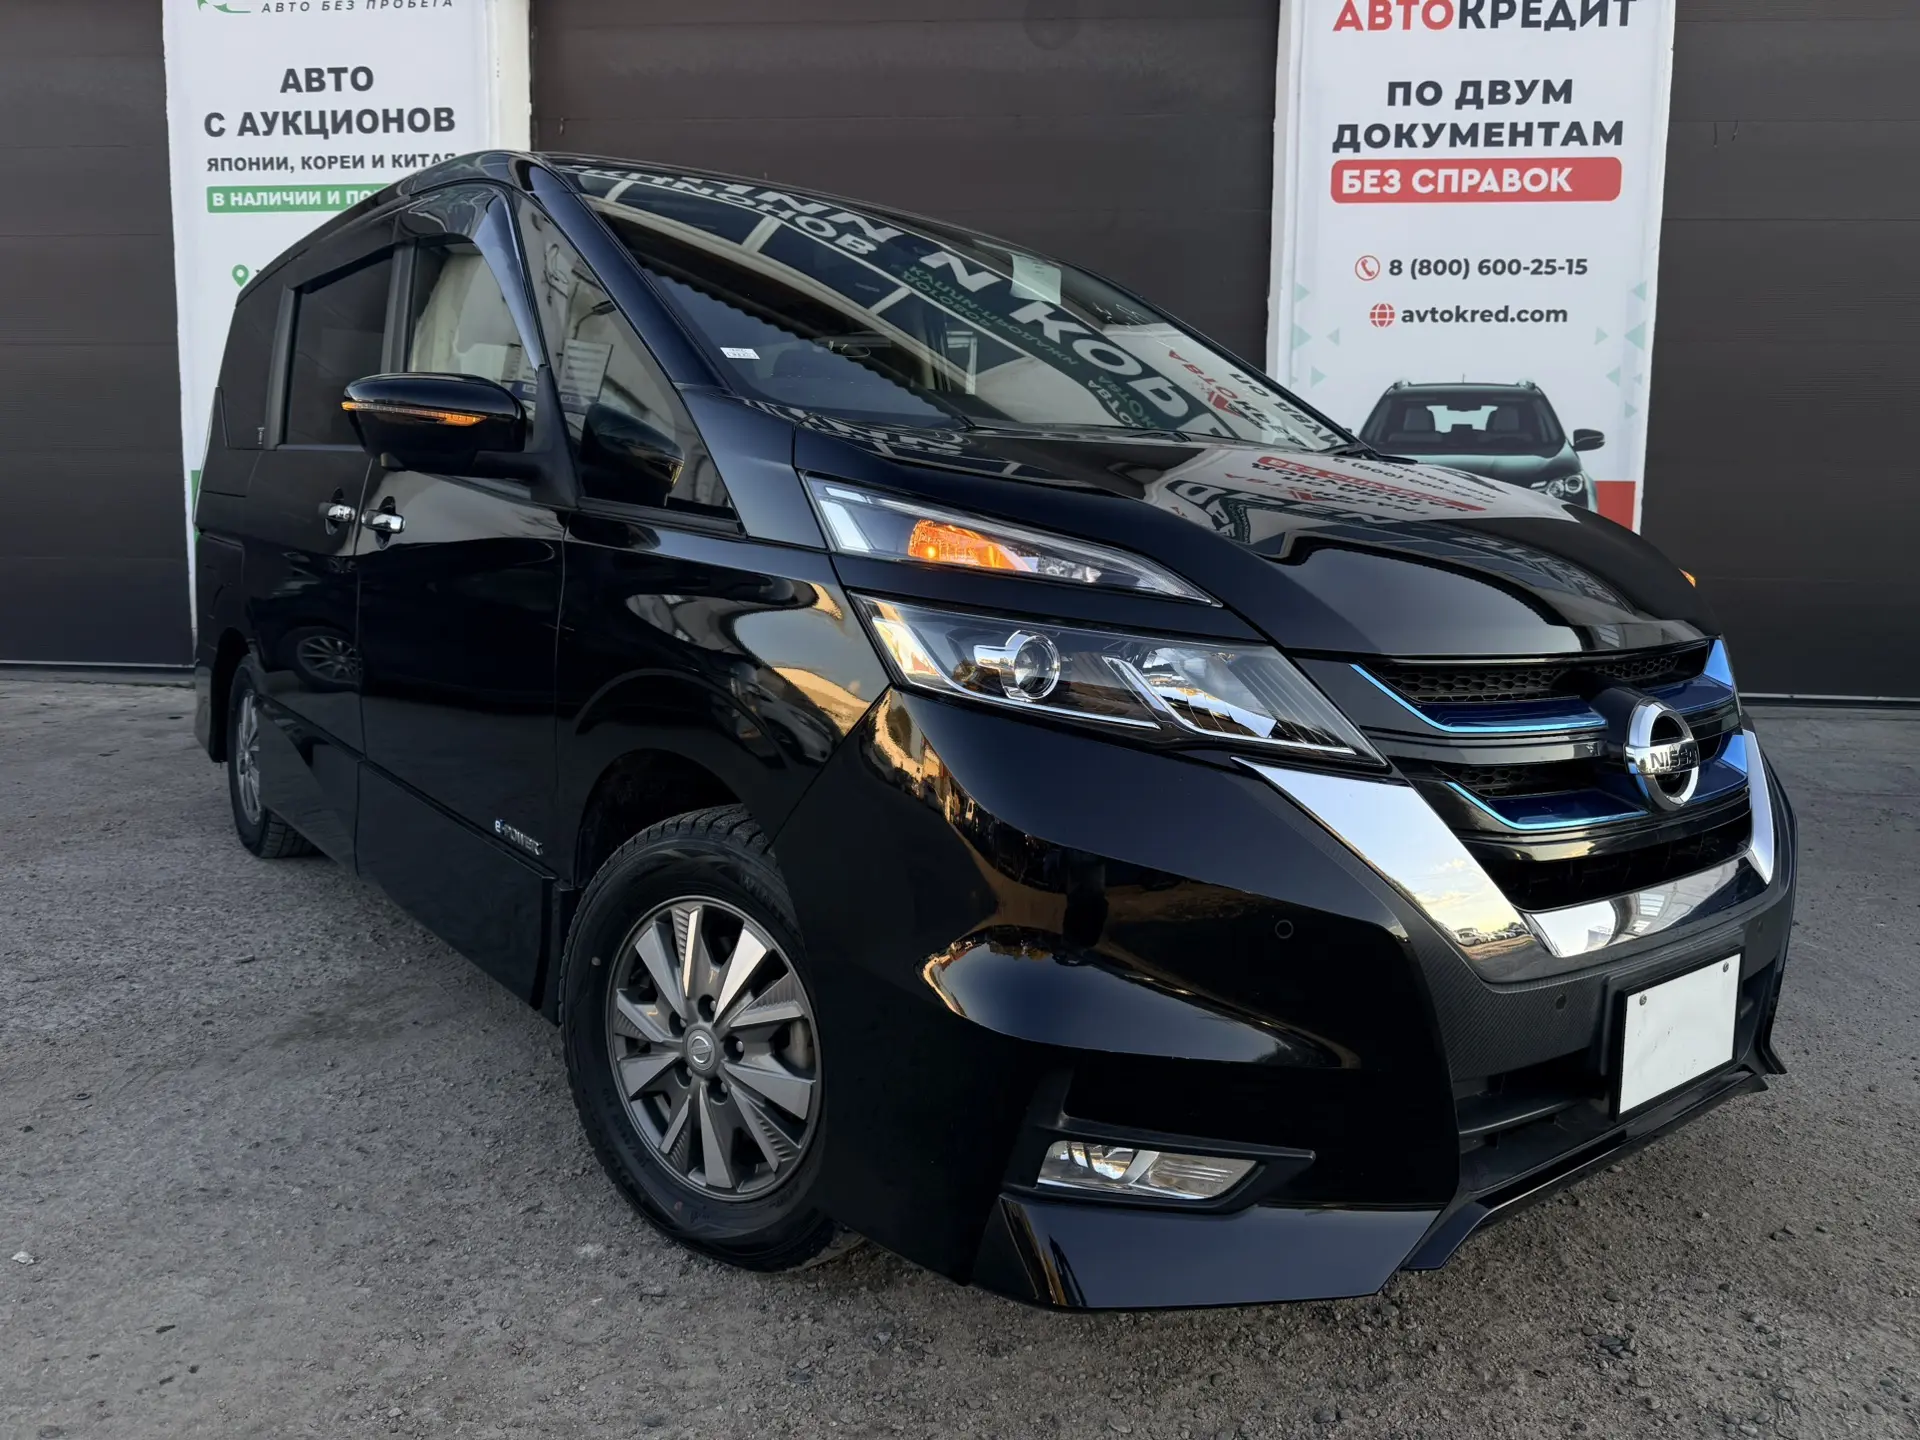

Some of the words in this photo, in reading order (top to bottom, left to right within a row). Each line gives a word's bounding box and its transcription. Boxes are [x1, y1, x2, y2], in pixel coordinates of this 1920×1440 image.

[261, 2, 310, 13] АВТО
[321, 0, 355, 12] БЕЗ
[1332, 0, 1637, 32] АВТОКРЕДИТ
[279, 66, 375, 94] АВТО
[1387, 80, 1443, 107] ПО
[1455, 78, 1574, 111] ДВУМ
[203, 112, 227, 138] С
[237, 106, 456, 140] АУКЦИОНОВ
[1332, 120, 1624, 154] ДОКУМЕНТАМ
[206, 156, 296, 173] ЯПОНИИ,
[301, 154, 366, 171] КОРЕИ
[372, 154, 385, 169] И
[1341, 168, 1402, 195] БЕЗ
[1411, 166, 1574, 194] СПРАВОК
[212, 192, 225, 207] В
[230, 190, 323, 207] НАЛИЧИИ
[327, 190, 341, 205] И
[346, 189, 377, 204] ПО
[1388, 259, 1403, 276] 8
[1410, 258, 1470, 281] (800)
[1477, 258, 1589, 277] 600-25-15
[1401, 305, 1569, 323] avtokred.com
